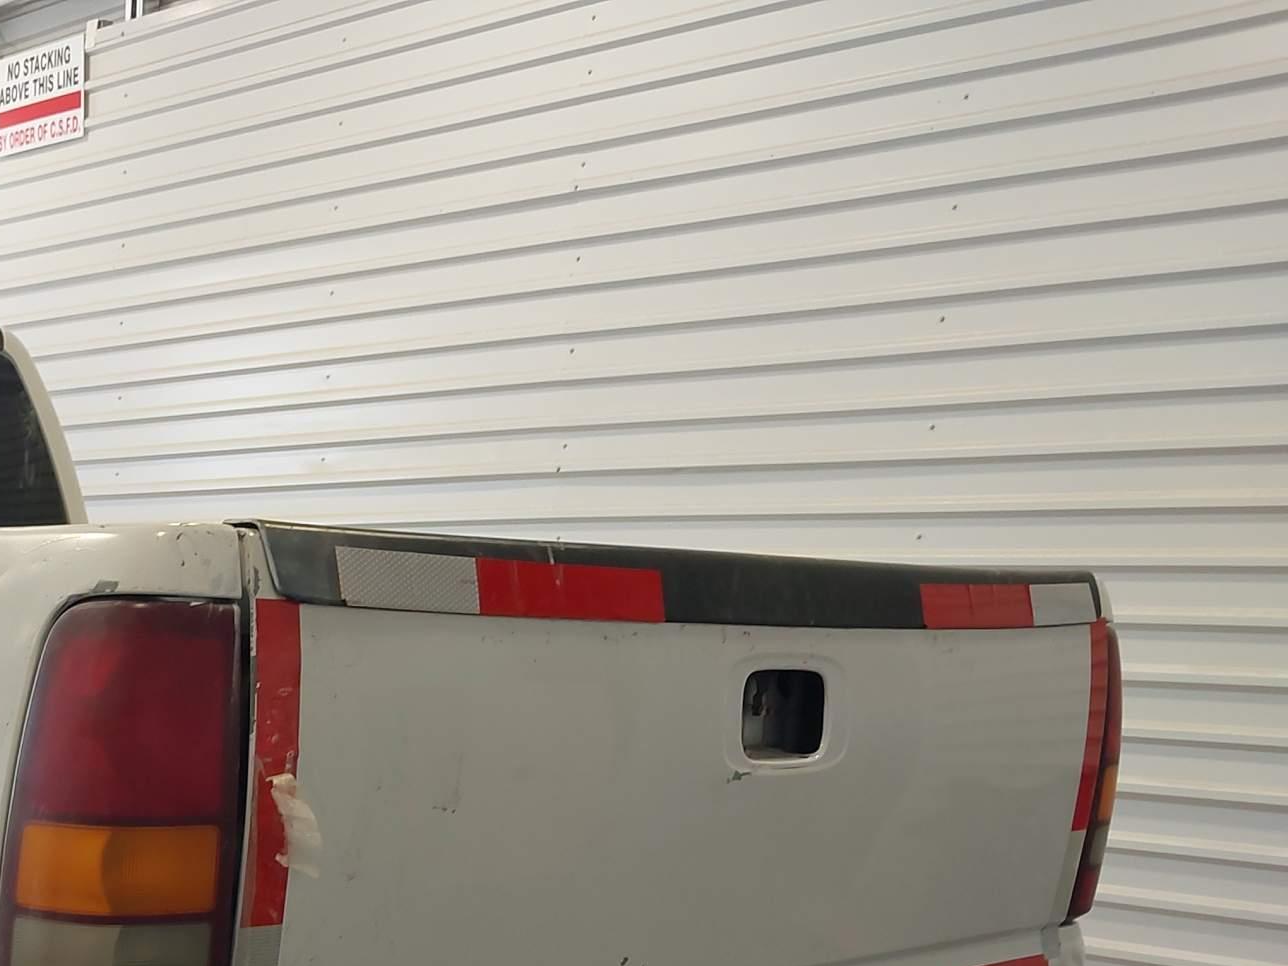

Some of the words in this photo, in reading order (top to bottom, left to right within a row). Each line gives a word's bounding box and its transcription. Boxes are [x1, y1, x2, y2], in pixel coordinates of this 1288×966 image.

[7, 61, 21, 82] NO
[23, 45, 71, 77] STACKING
[0, 81, 30, 107] ABOVE
[33, 74, 54, 97] THIS
[57, 66, 80, 90] LINE
[9, 127, 35, 149] ORDER
[37, 123, 48, 142] OF
[50, 115, 81, 139] C.S.F.D.
